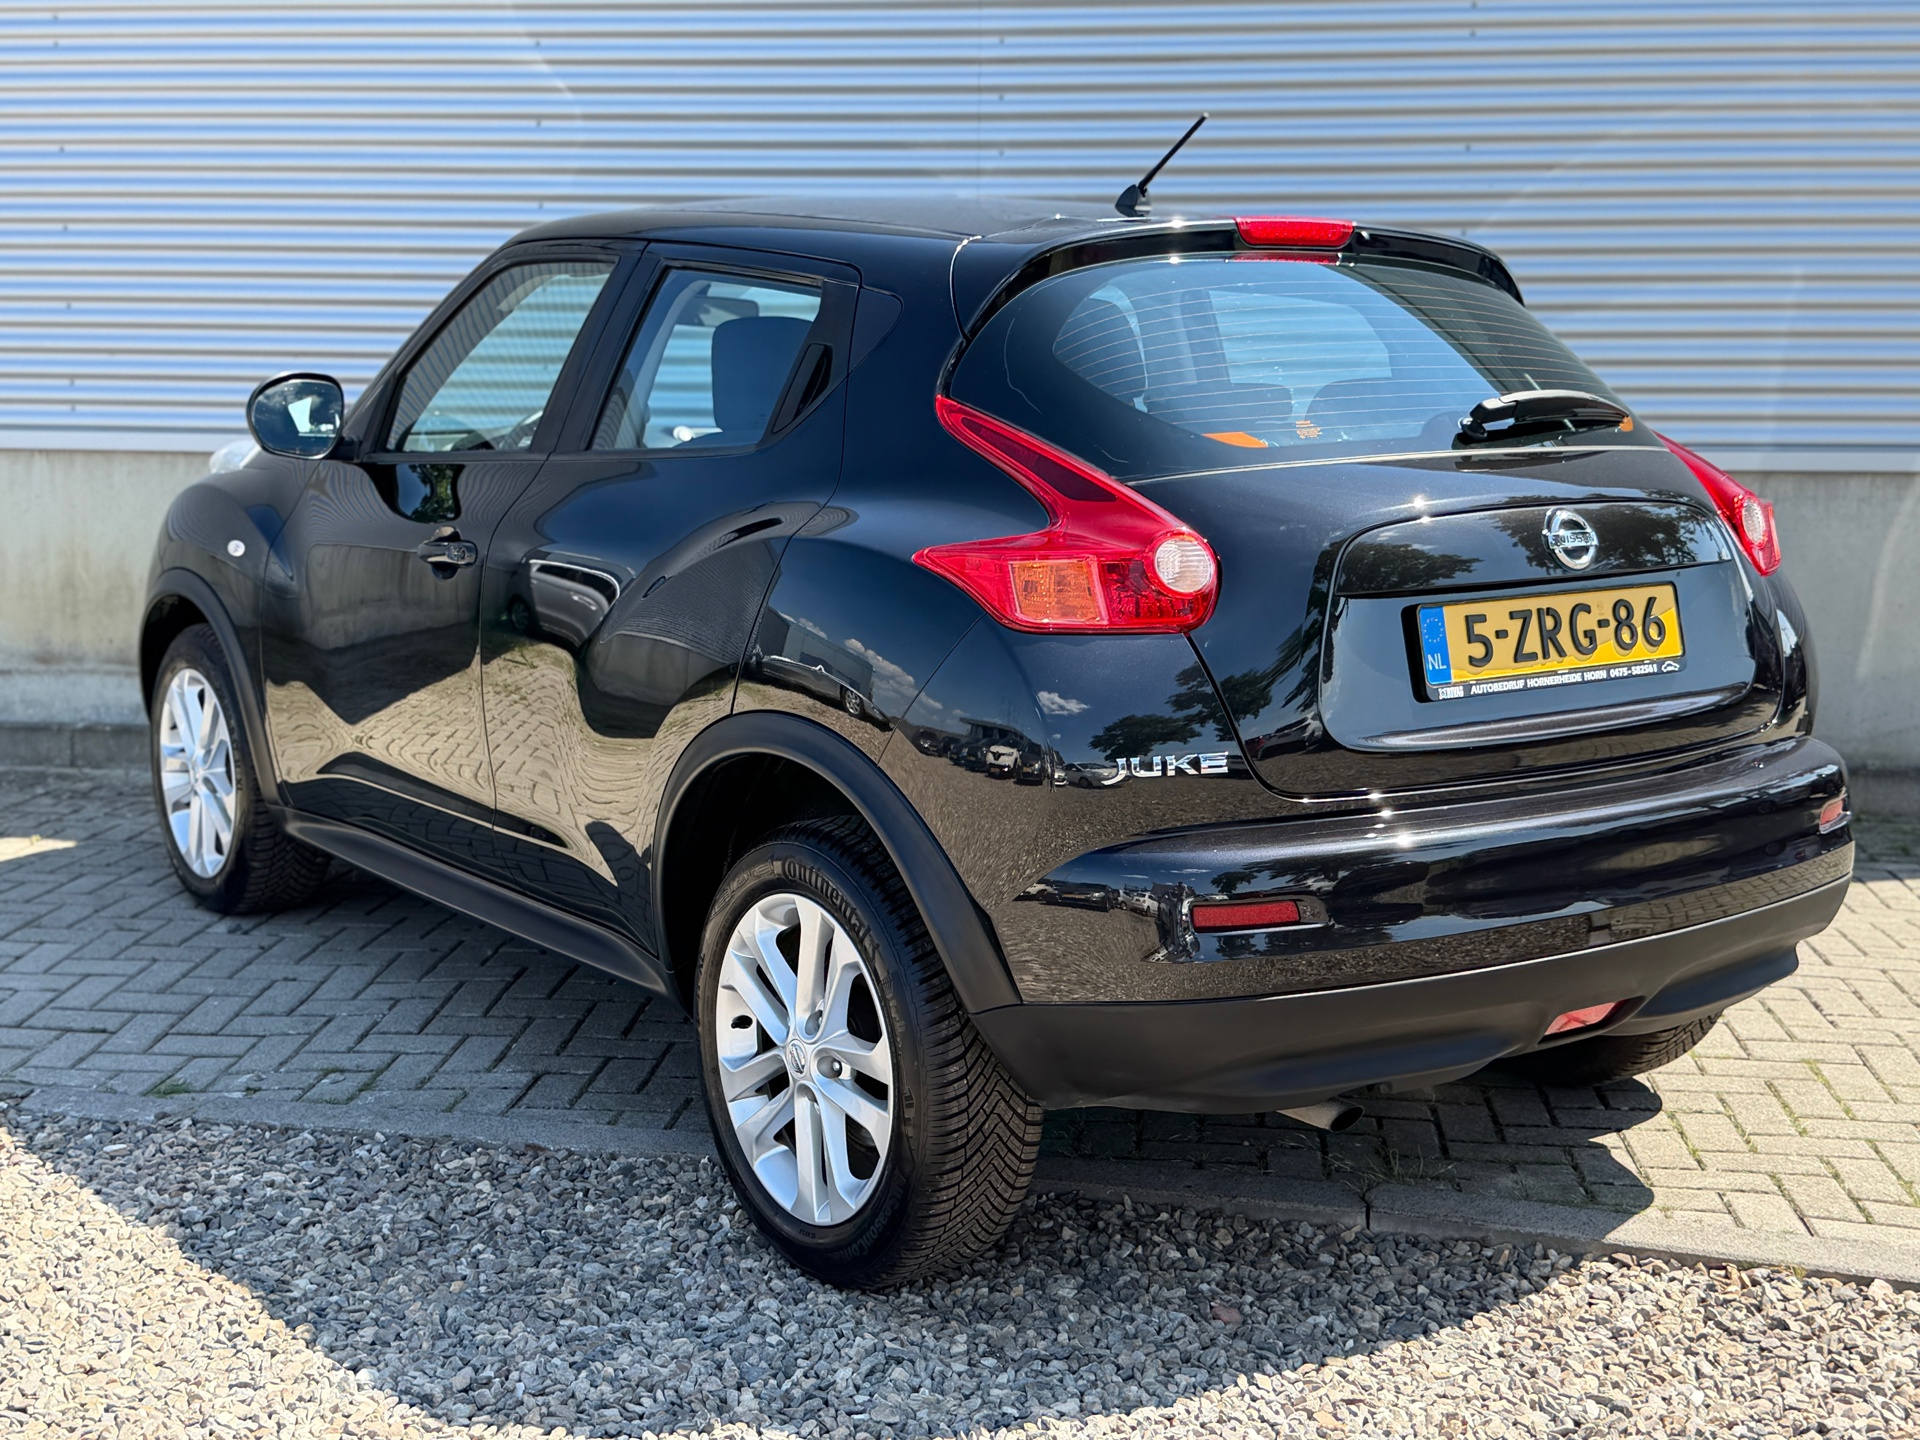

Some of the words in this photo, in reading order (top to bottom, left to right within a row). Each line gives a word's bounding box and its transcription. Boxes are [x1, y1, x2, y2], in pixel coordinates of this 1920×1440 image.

[1465, 597, 1666, 667] 5-ZRG-86
[1428, 653, 1447, 670] NL
[1470, 680, 1525, 695] AUTOBEDRIJF
[1527, 673, 1583, 688] HORNERHEIDE
[1584, 669, 1607, 682] HORN
[1101, 751, 1229, 785] JUKE
[781, 857, 872, 941] Continental
